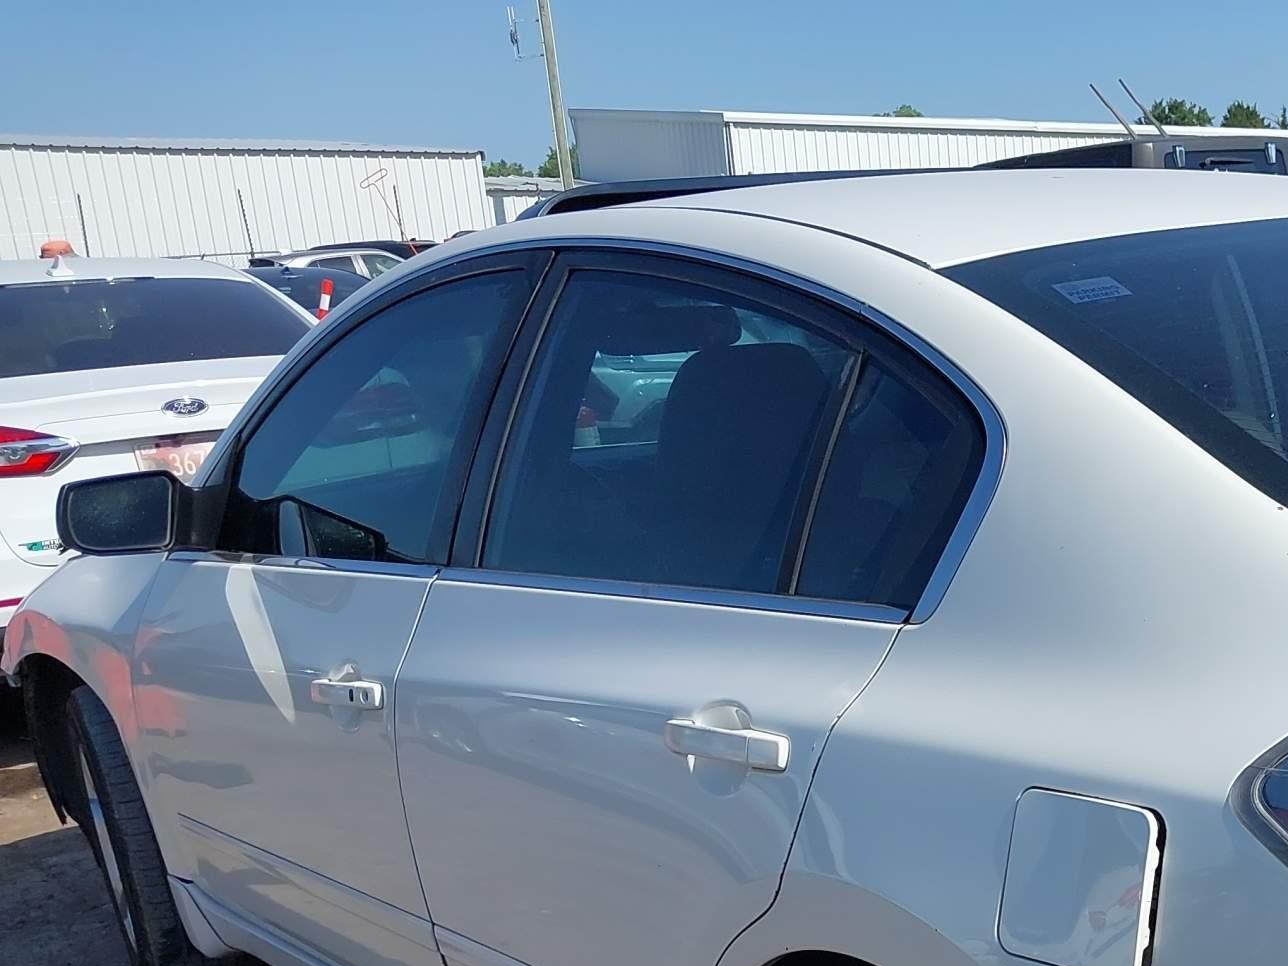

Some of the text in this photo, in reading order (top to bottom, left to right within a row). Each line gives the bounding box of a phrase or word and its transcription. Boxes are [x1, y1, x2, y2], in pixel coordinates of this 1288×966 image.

[1066, 285, 1121, 297] PARKING
[1077, 290, 1121, 301] PERMIT
[171, 400, 199, 415] Ford
